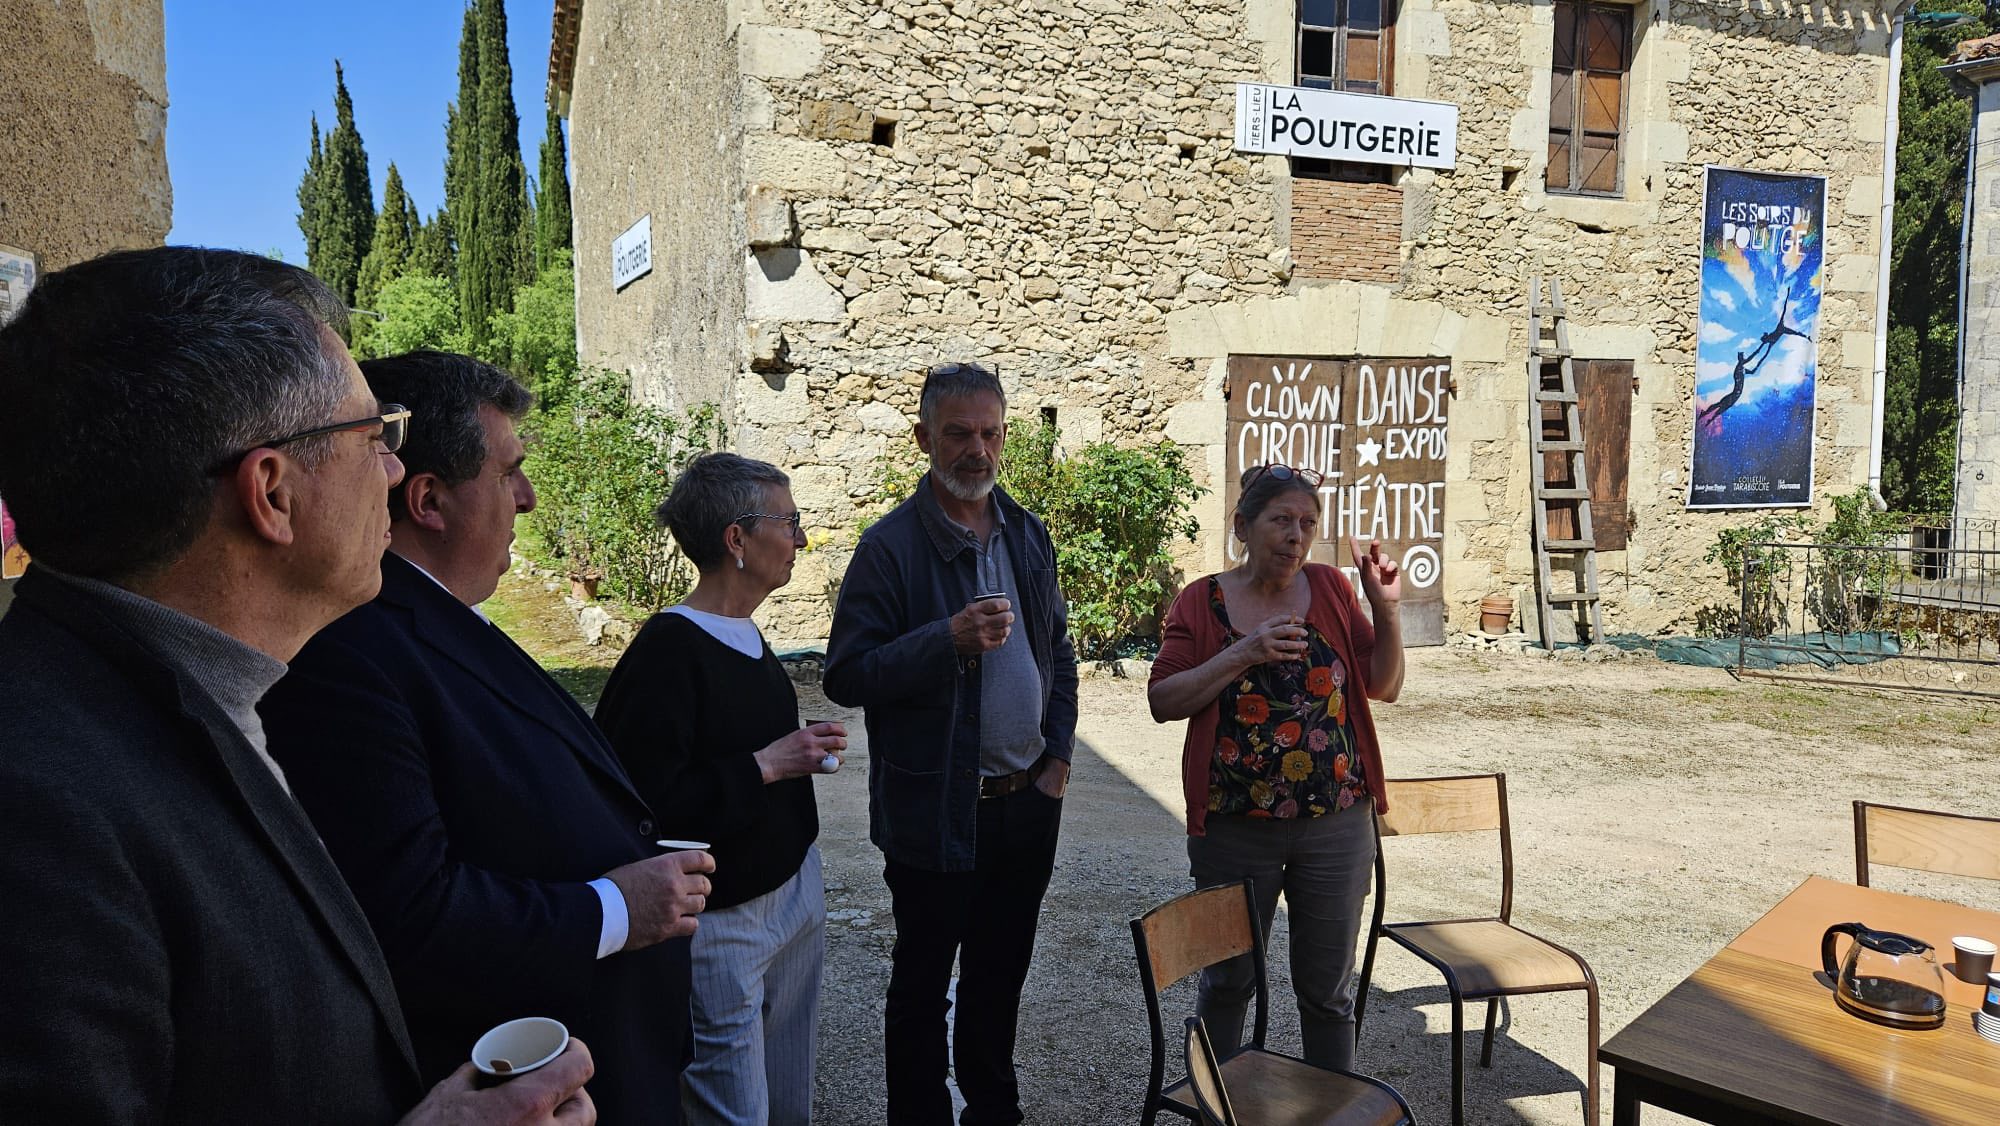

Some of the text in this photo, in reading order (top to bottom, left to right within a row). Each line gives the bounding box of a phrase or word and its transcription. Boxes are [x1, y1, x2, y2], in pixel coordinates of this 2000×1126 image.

[1272, 90, 1302, 111] LA
[1722, 201, 1746, 222] LES
[1749, 203, 1791, 224] SOIRS
[1246, 381, 1341, 421] CLOWN
[1357, 364, 1450, 426] DANSE
[1238, 421, 1346, 478] CIRQUE
[1385, 427, 1448, 460] EXPOS
[1318, 472, 1445, 541] THÉÂTRE
